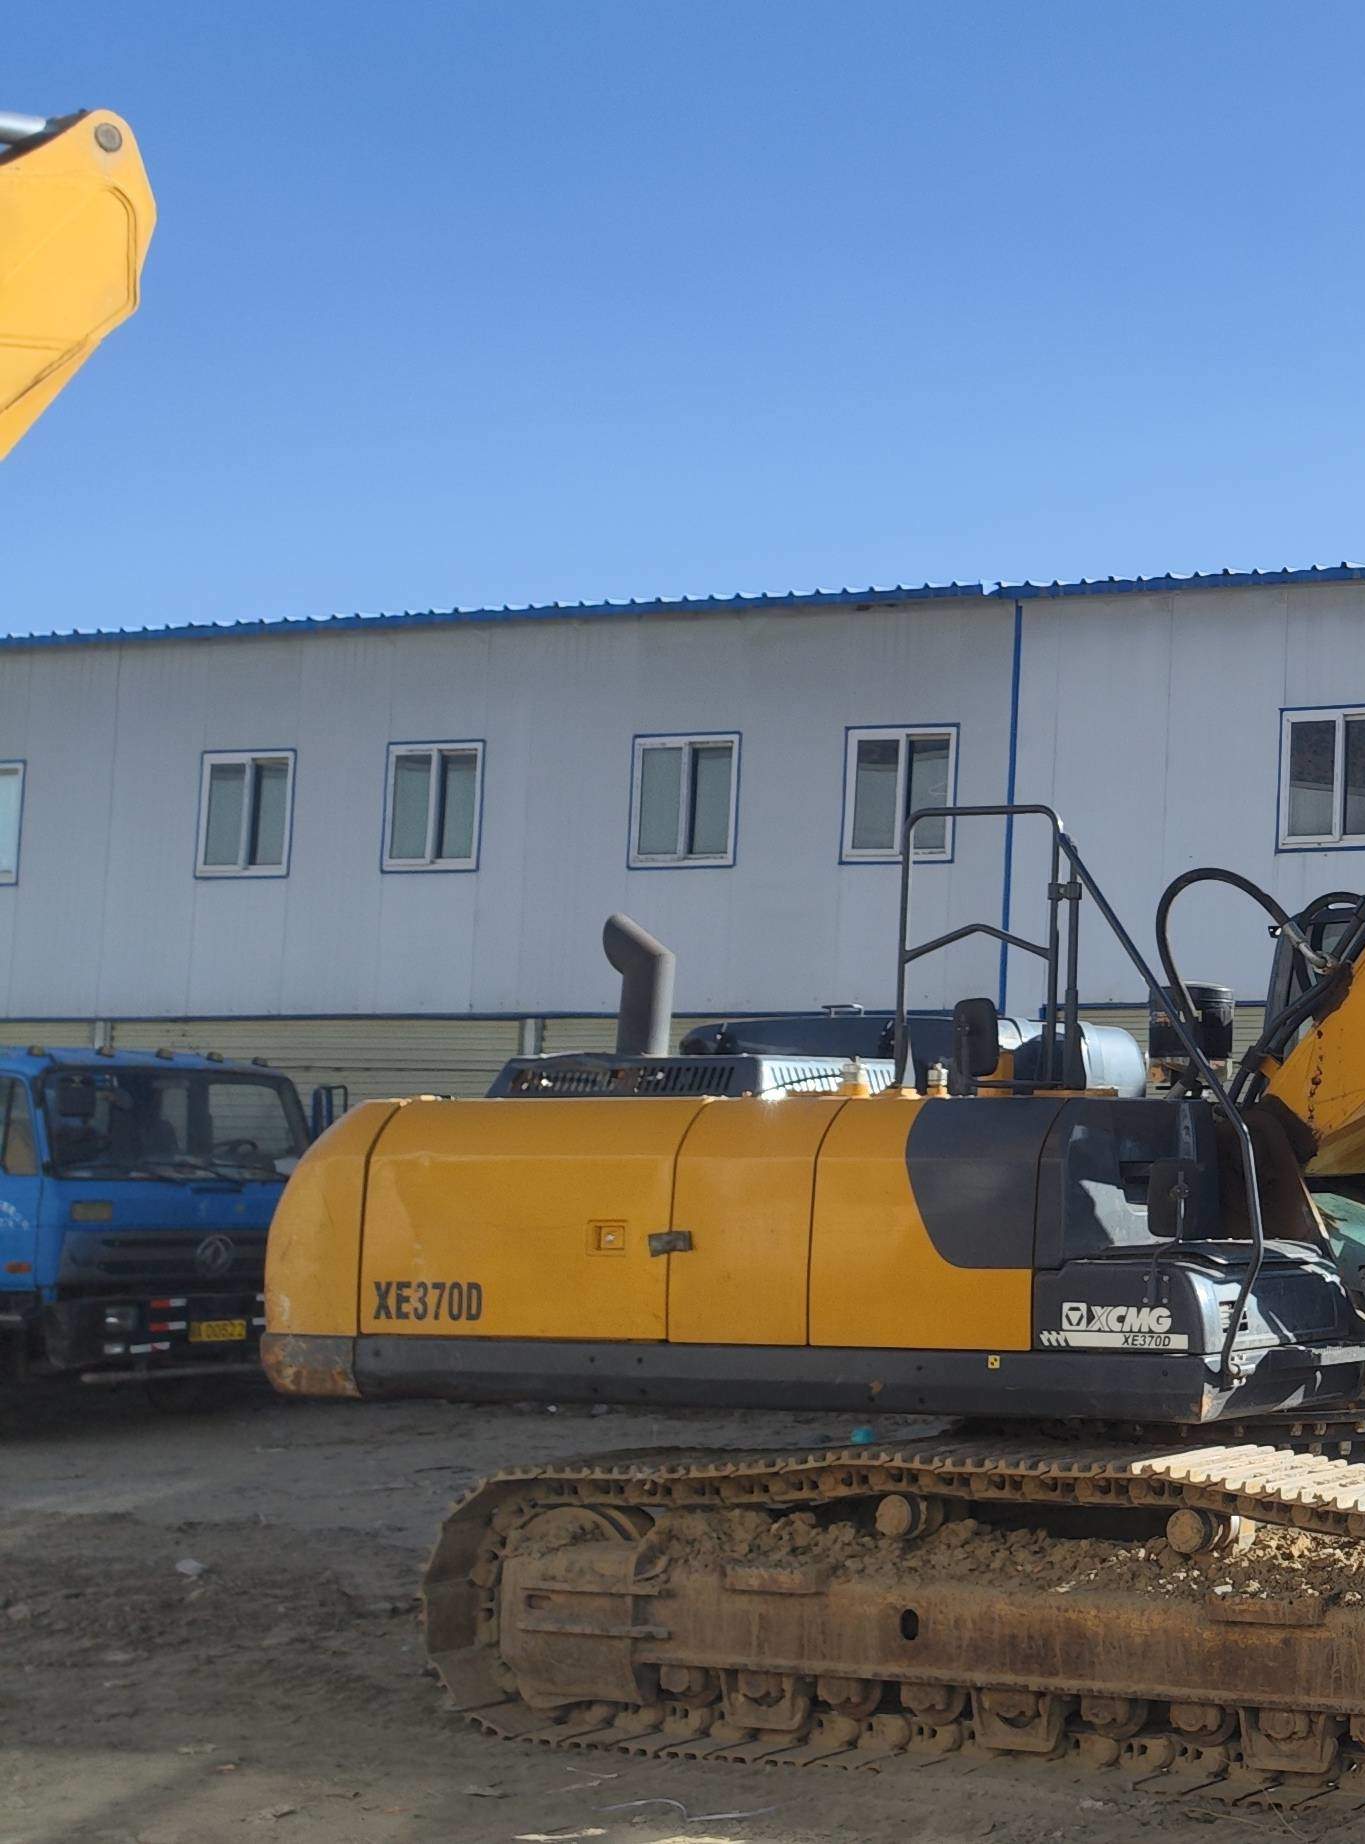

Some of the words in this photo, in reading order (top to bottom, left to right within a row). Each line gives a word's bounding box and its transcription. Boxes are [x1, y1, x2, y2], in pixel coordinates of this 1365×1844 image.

[373, 1280, 483, 1322] XE370D
[1086, 1305, 1172, 1333] XCMG
[1121, 1334, 1171, 1347] XE370D
